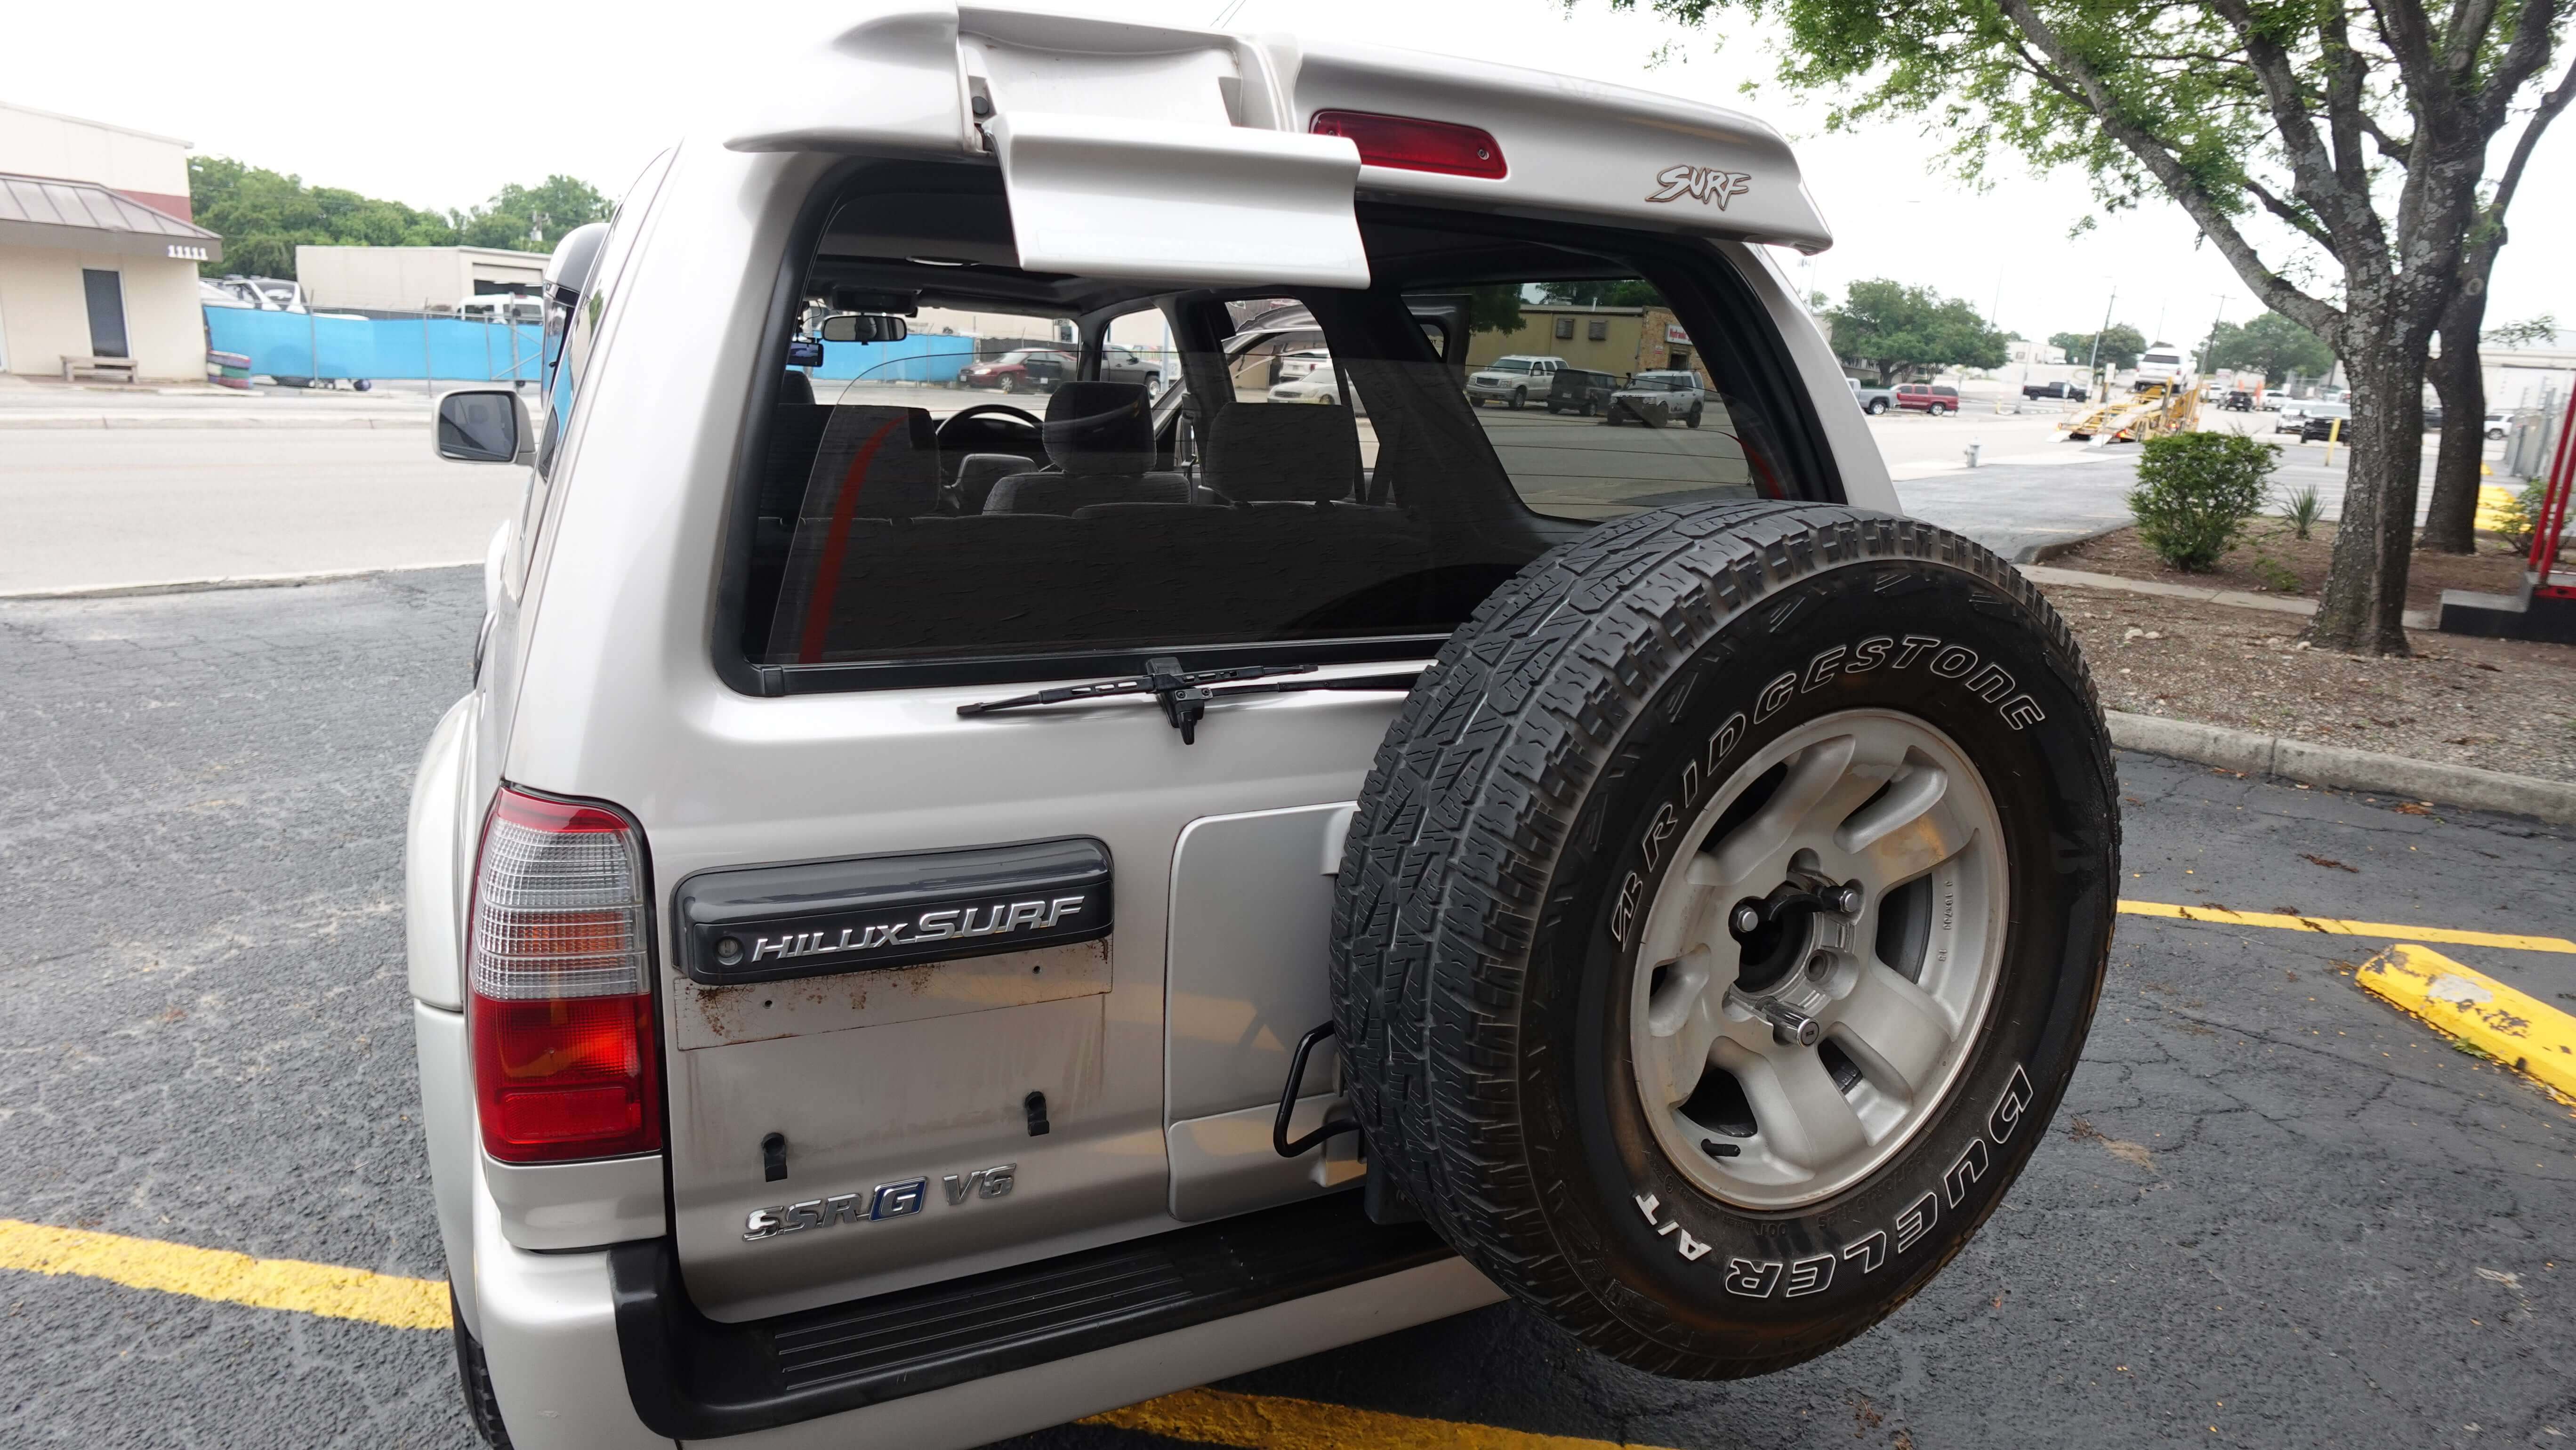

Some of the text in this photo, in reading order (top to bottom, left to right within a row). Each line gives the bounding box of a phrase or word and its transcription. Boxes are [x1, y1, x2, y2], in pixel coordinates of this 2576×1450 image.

[1645, 164, 1752, 211] SURF
[1612, 634, 2045, 952] BRIDGESTONE
[751, 895, 1085, 962] HILUX SURF
[943, 1162, 1017, 1206] V6
[1632, 1064, 2034, 1298] DUELER A/T
